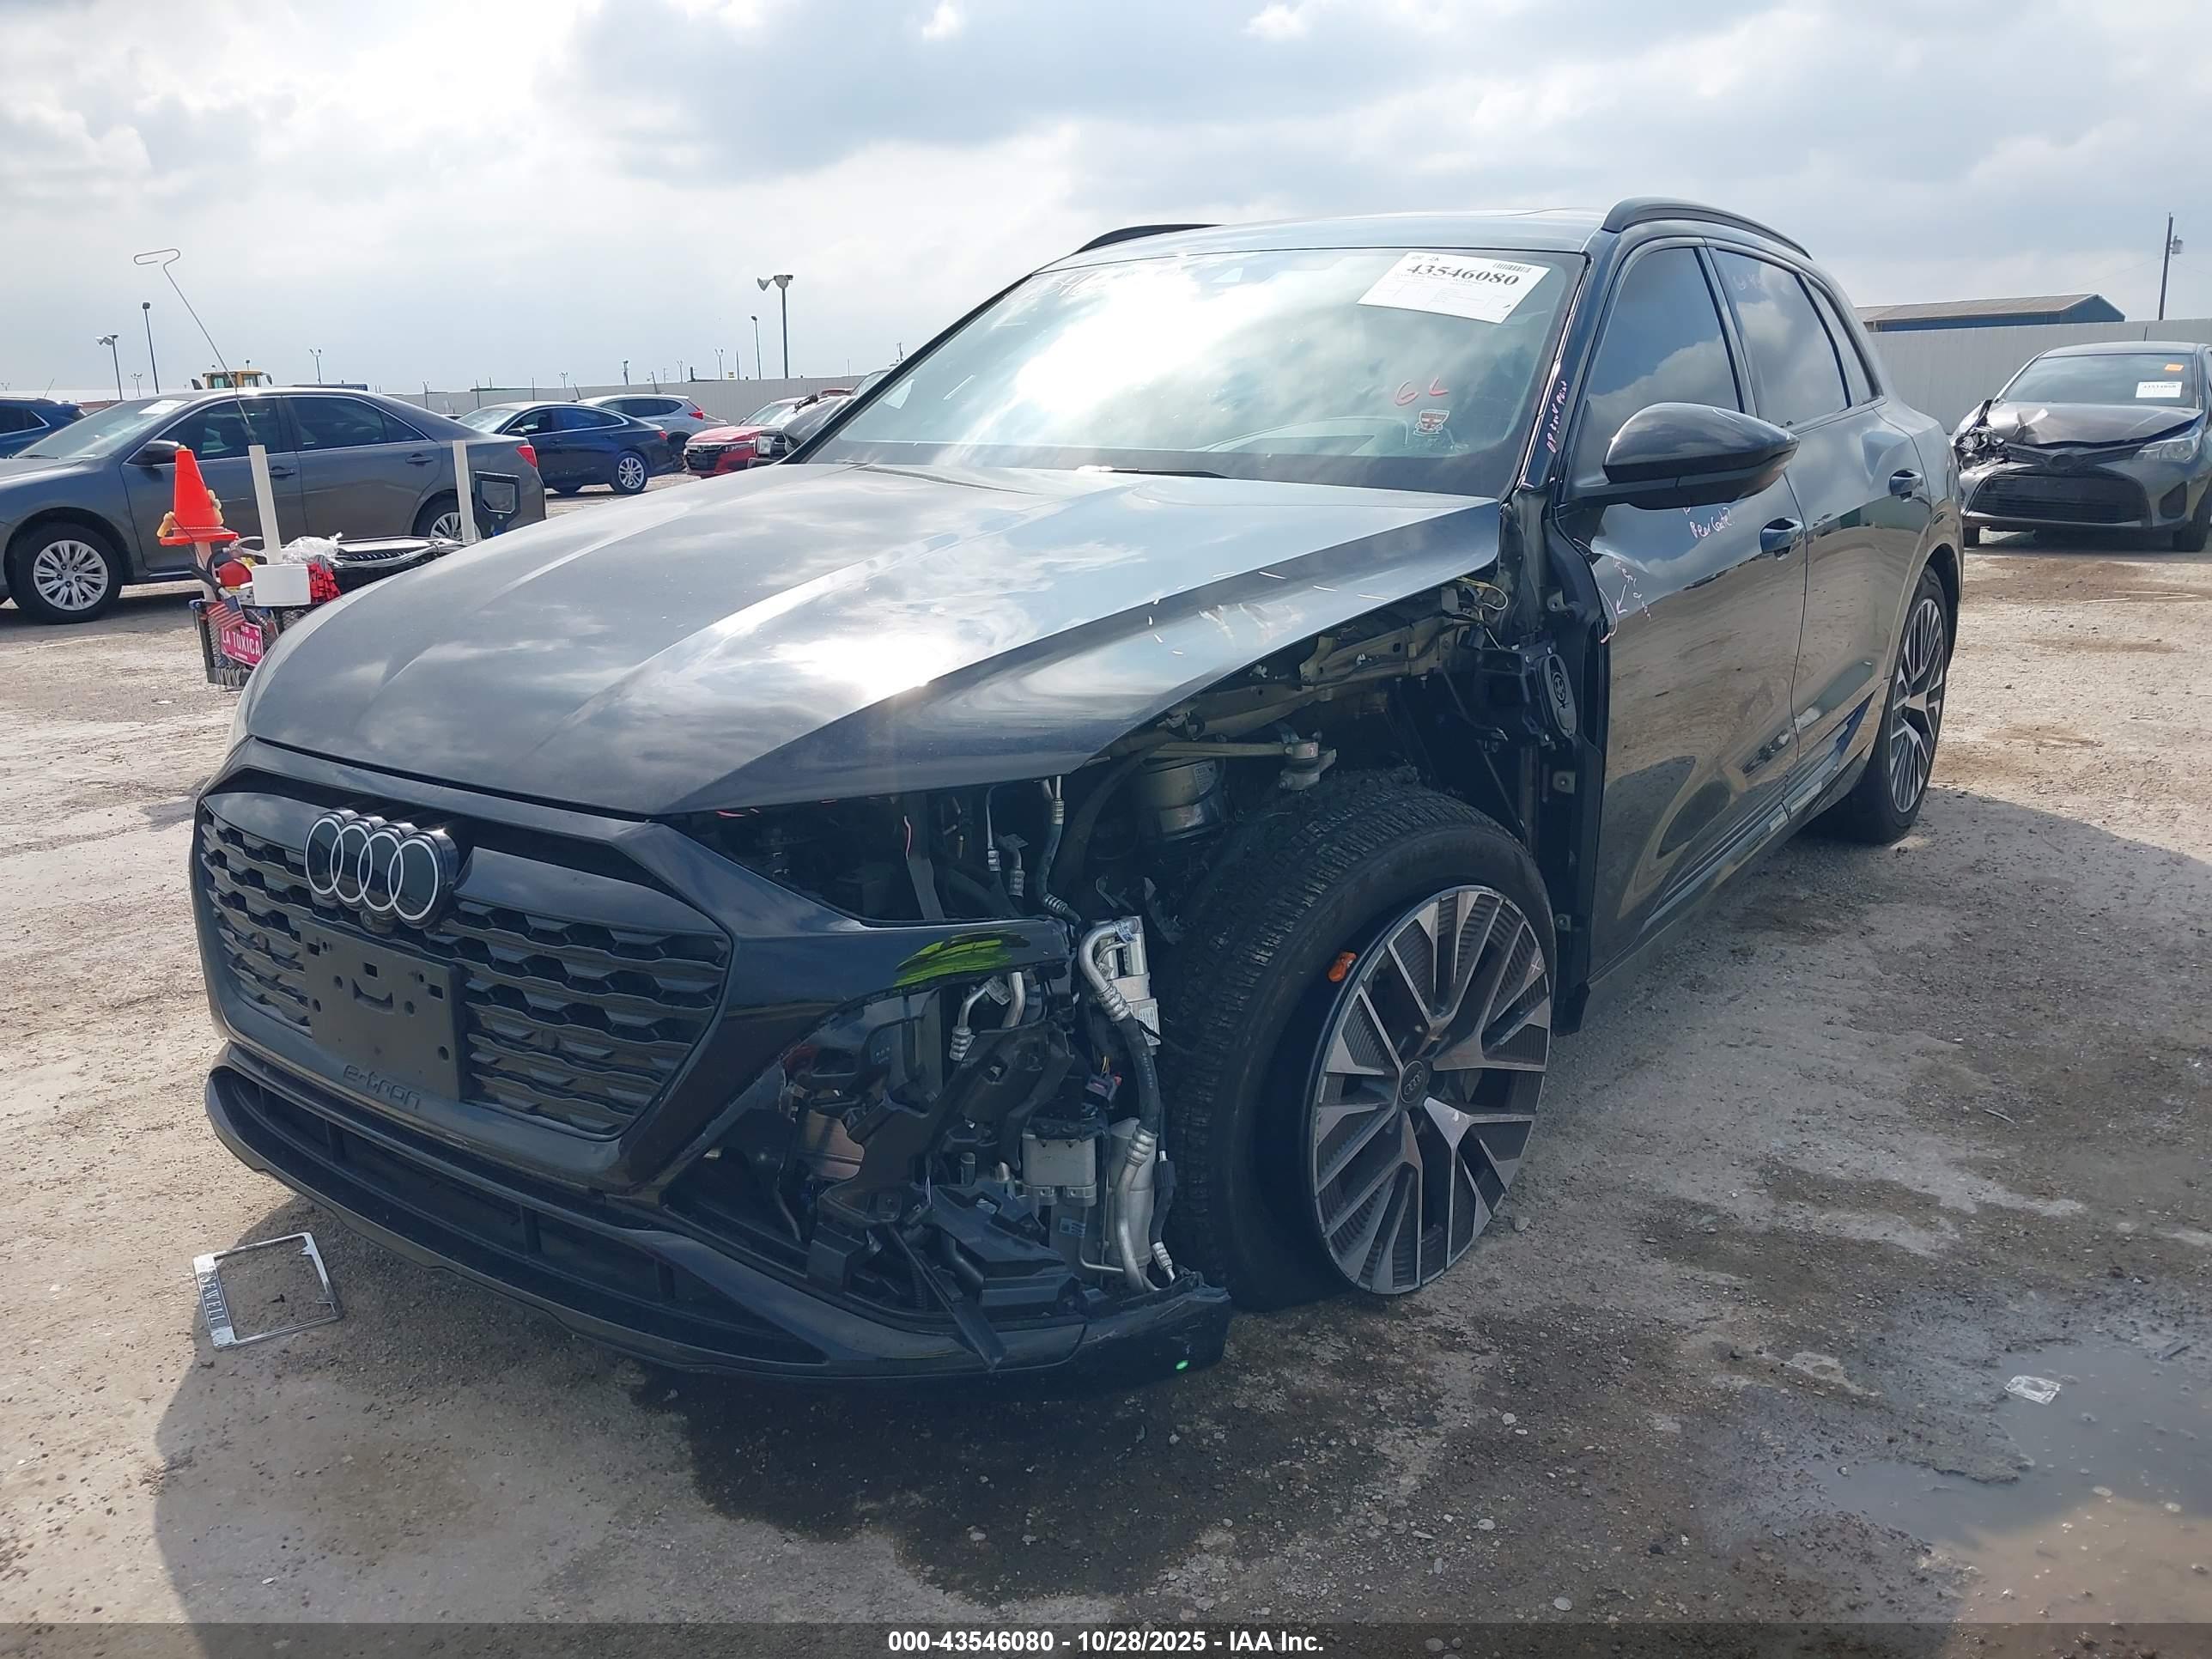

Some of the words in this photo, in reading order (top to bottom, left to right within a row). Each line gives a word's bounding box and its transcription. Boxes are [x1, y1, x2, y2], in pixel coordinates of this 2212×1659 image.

[1407, 263, 1520, 286] 43546080
[222, 627, 231, 647] LA
[232, 631, 261, 657] TOXICA
[343, 1064, 421, 1110] e-tron
[198, 1273, 226, 1325] SEWELL
